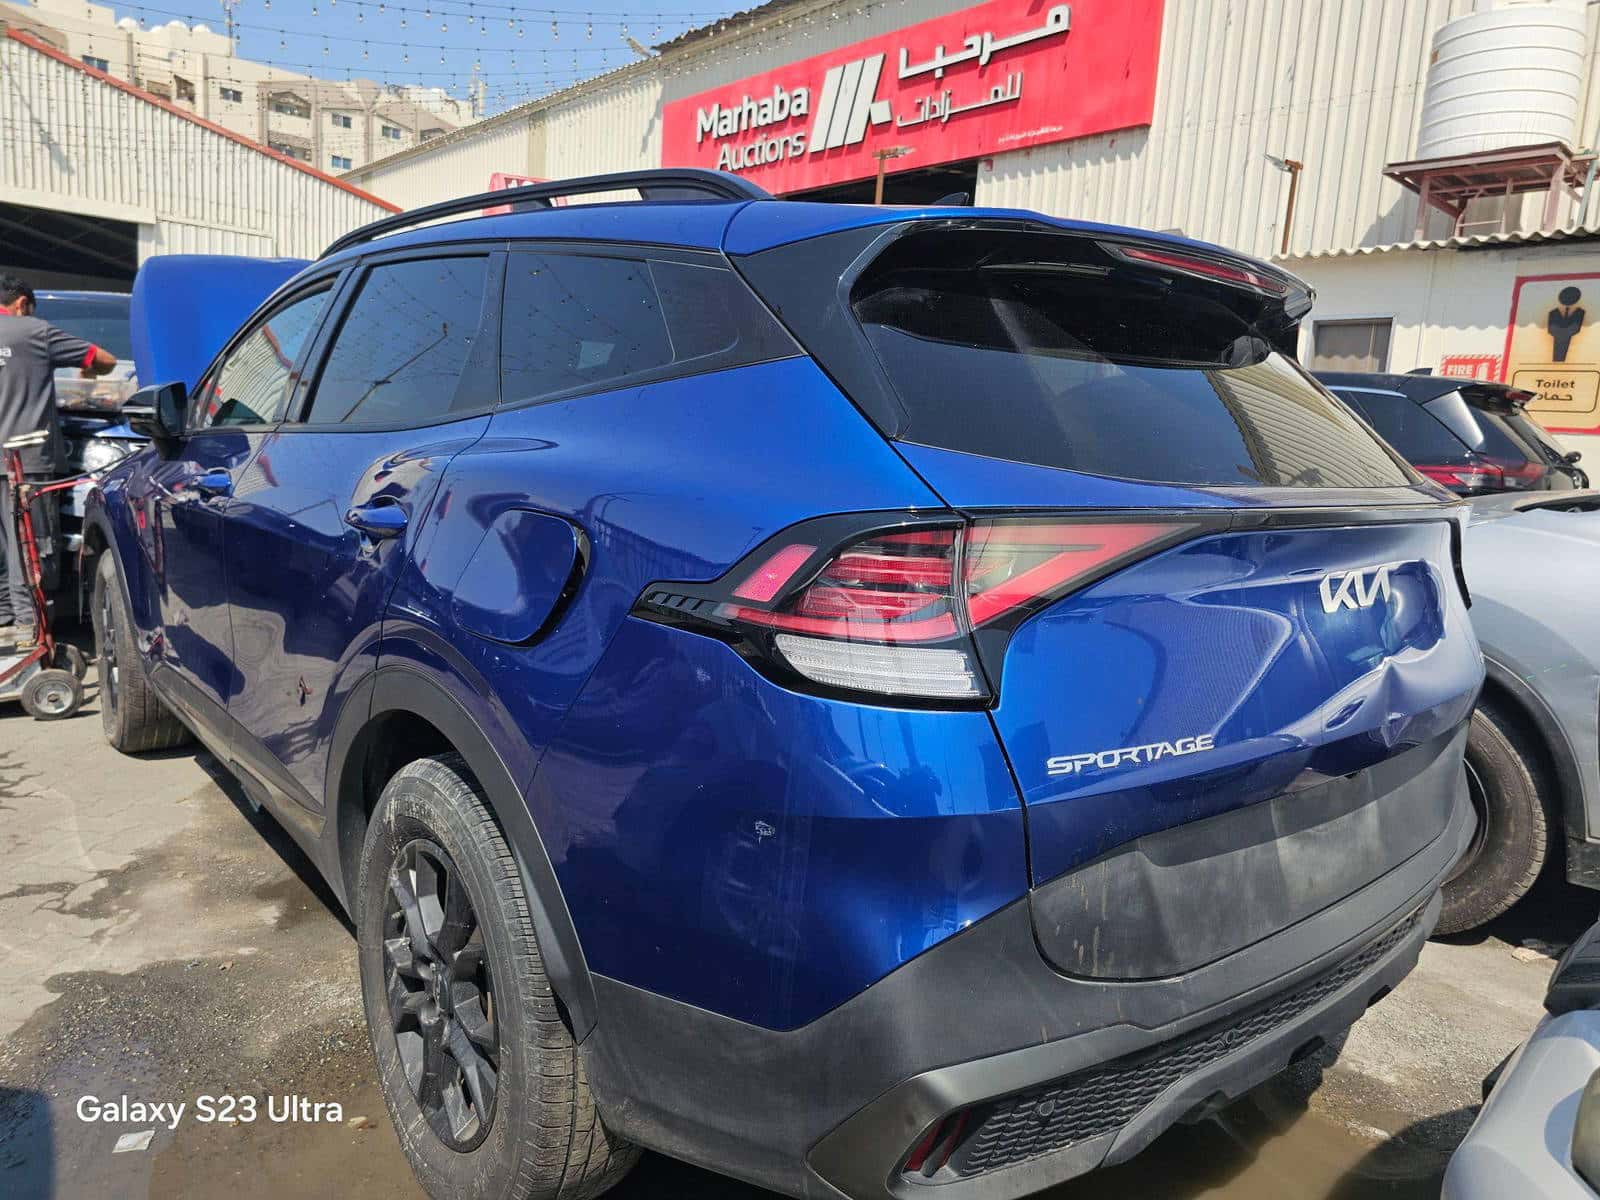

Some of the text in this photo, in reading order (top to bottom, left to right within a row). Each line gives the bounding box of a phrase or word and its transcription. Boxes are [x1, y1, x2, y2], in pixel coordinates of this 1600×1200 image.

[898, 4, 1071, 79] مرحبا
[696, 85, 809, 144] Marhaba
[896, 71, 1023, 127] للمزادات
[716, 132, 806, 171] Auctions
[1447, 364, 1473, 376] FIRE
[1536, 379, 1575, 388] Toilet
[1319, 567, 1391, 613] KIA
[1047, 733, 1215, 776] SPORTAGE
